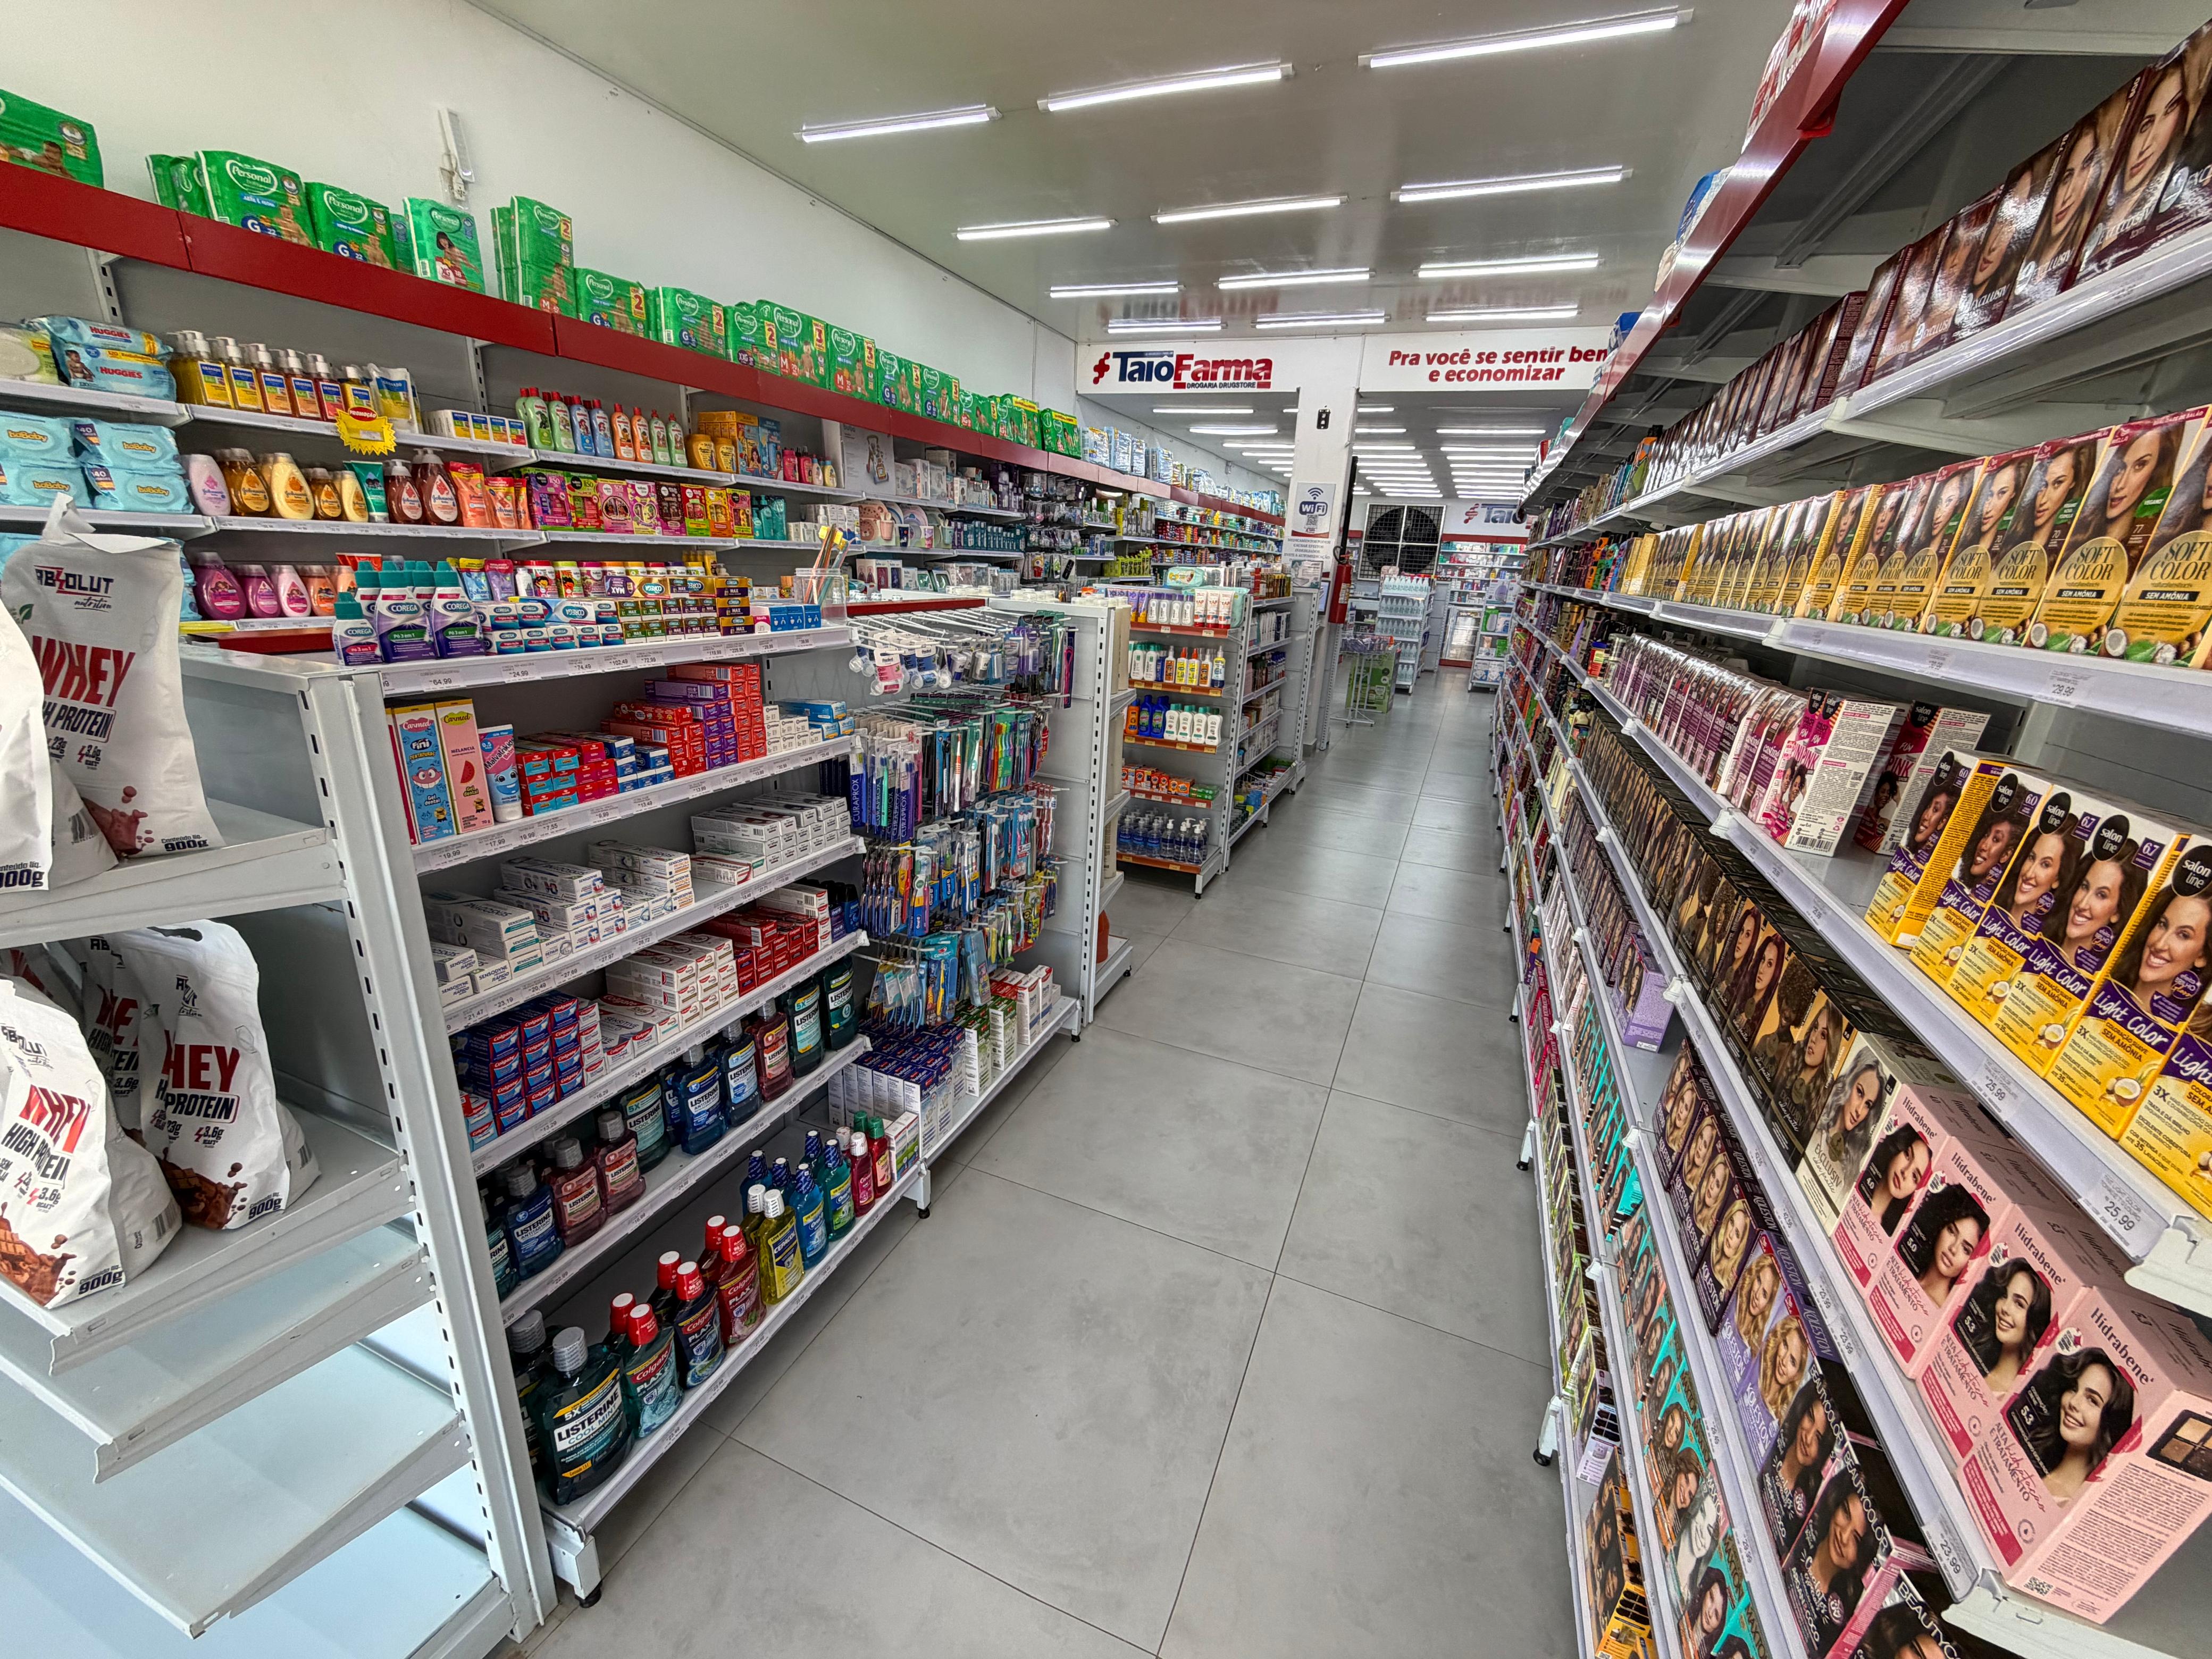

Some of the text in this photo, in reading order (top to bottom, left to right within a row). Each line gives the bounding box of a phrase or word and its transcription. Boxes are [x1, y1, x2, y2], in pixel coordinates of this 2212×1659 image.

[232, 165, 271, 184] Personal
[329, 196, 363, 214] Personal
[247, 219, 261, 233] G
[338, 244, 349, 257] G
[589, 280, 610, 290] Personal
[634, 294, 643, 311] 2
[593, 315, 601, 325] G
[716, 312, 723, 328] 2
[89, 326, 131, 339] HUGGIES
[682, 331, 689, 340] G
[767, 328, 775, 341] 2
[815, 330, 823, 344] 3
[866, 347, 873, 360] 3
[1389, 350, 1420, 366] Pra
[1426, 348, 1472, 365] você
[1475, 351, 1497, 365] se
[1502, 346, 1565, 364] sentir
[99, 366, 143, 379] HUGGIES
[1428, 365, 1565, 382] e economizar
[2133, 524, 2143, 533] 77
[2008, 550, 2039, 565] SOFT
[2077, 546, 2116, 564] SOFT
[1998, 565, 2037, 580] COLOR
[2065, 564, 2114, 581] COLOR
[2150, 562, 2210, 581] COLOR
[2075, 590, 2097, 599] AMÔNIA
[2160, 591, 2189, 601] AMÔNIA
[390, 604, 418, 612] COREGA
[446, 602, 471, 611] COREGA
[348, 628, 373, 636] COREGA
[32, 635, 136, 707] WHEY
[443, 713, 471, 724] Carmed
[1916, 705, 1932, 716] salon
[1917, 714, 1928, 723] line
[52, 704, 113, 739] PROTEIN
[403, 720, 432, 731] Carmed
[412, 738, 430, 749] Fini
[1887, 754, 1915, 777] PINK
[1997, 784, 2013, 797] salon
[1998, 794, 2009, 805] line
[2046, 804, 2065, 817] salon
[2048, 814, 2061, 827] line
[2099, 828, 2123, 843] salon
[164, 838, 209, 852] 900g
[2102, 841, 2118, 853] line
[2182, 859, 2211, 877] salon
[2186, 873, 2205, 889] line
[1940, 887, 1980, 920] Light Color
[507, 916, 530, 926] SENSODYNE
[1981, 916, 2030, 955] Light Color
[449, 954, 475, 969] SENSODYNE
[479, 965, 508, 981] SENSODYNE
[2029, 951, 2088, 996] Light Color
[441, 981, 469, 994] SENSODYNE
[2014, 979, 2026, 992] 3X
[555, 1001, 575, 1013] Colgate
[524, 1015, 545, 1027] Colgate
[605, 1016, 640, 1030] SENSITIVE
[2092, 991, 2169, 1046] Light Color
[493, 1029, 515, 1043] Colgate
[2076, 1025, 2090, 1039] 3X
[2101, 1028, 2143, 1062] SEM AMÔNIA
[690, 1085, 719, 1108] LISTERINE
[1985, 1078, 2006, 1102] 25,99
[2152, 1085, 2169, 1102] 3X
[165, 1093, 235, 1120] PROTEIN
[1902, 1096, 1934, 1139] Hidrabene
[611, 1159, 635, 1177] LISTERINE
[1950, 1152, 1993, 1204] Hidrabene
[569, 1188, 595, 1209] LISTERINE
[248, 1196, 282, 1220] 900g
[2104, 1201, 2135, 1231] 25,99
[516, 1211, 552, 1238] LISTERINE
[2014, 1222, 2064, 1286] Hidrabene
[79, 1270, 123, 1296] 900g
[1702, 1261, 1721, 1312] KOLESTON
[686, 1308, 715, 1332] Colgate
[1804, 1308, 1833, 1356] KOLESTON
[1724, 1318, 1746, 1376] KOLESTON
[2090, 1306, 2150, 1386] Hidrabene
[636, 1350, 668, 1381] Colgate
[1810, 1363, 1845, 1444] BEAUTYCOLOR
[558, 1388, 619, 1442] LISTERINE
[565, 1404, 582, 1421] 5X
[1746, 1381, 1771, 1449] KOLESTON
[568, 1426, 596, 1445] COOL
[598, 1405, 617, 1426] MINT
[1706, 1470, 1725, 1527] MAXTON
[1844, 1451, 1888, 1551] BEAUTYCOLOR
[1940, 1541, 1961, 1574] 23,99
